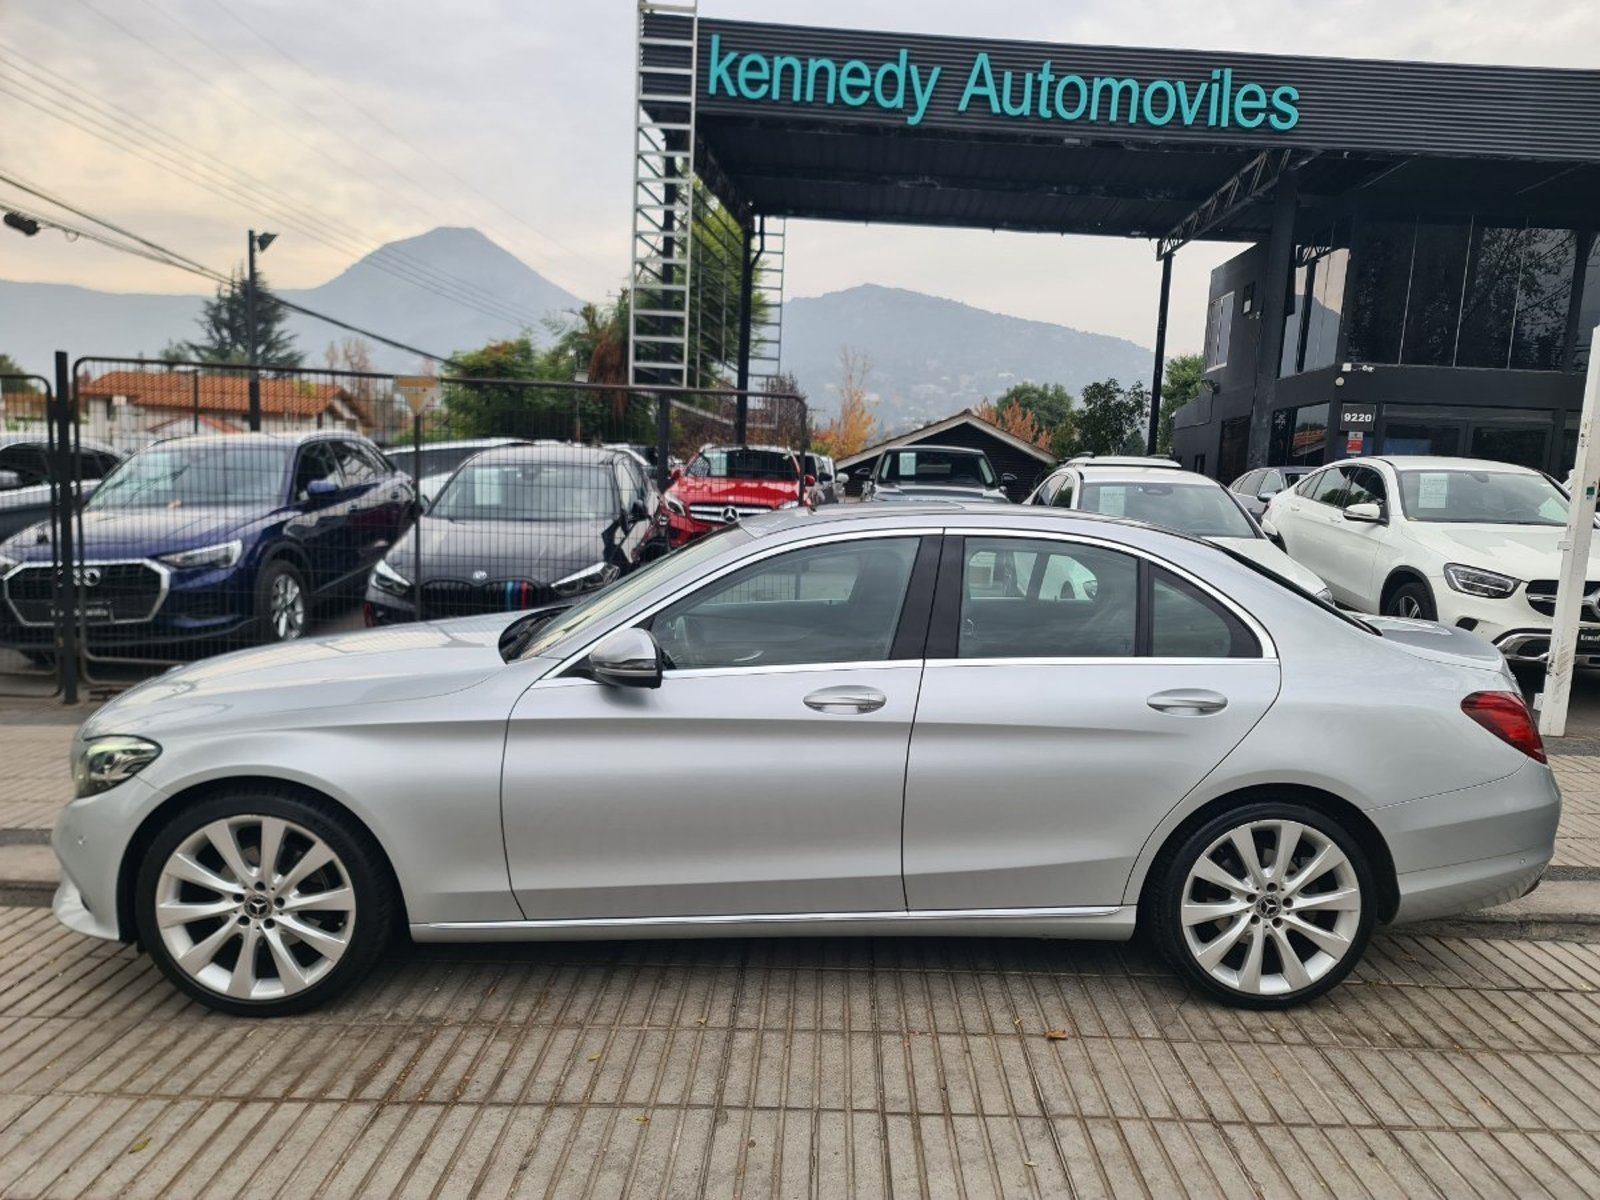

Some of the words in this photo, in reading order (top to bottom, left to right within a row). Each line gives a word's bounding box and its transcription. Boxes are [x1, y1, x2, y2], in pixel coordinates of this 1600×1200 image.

[707, 33, 942, 126] kennedy
[957, 51, 1301, 132] Automoviles
[1343, 412, 1372, 422] 9220
